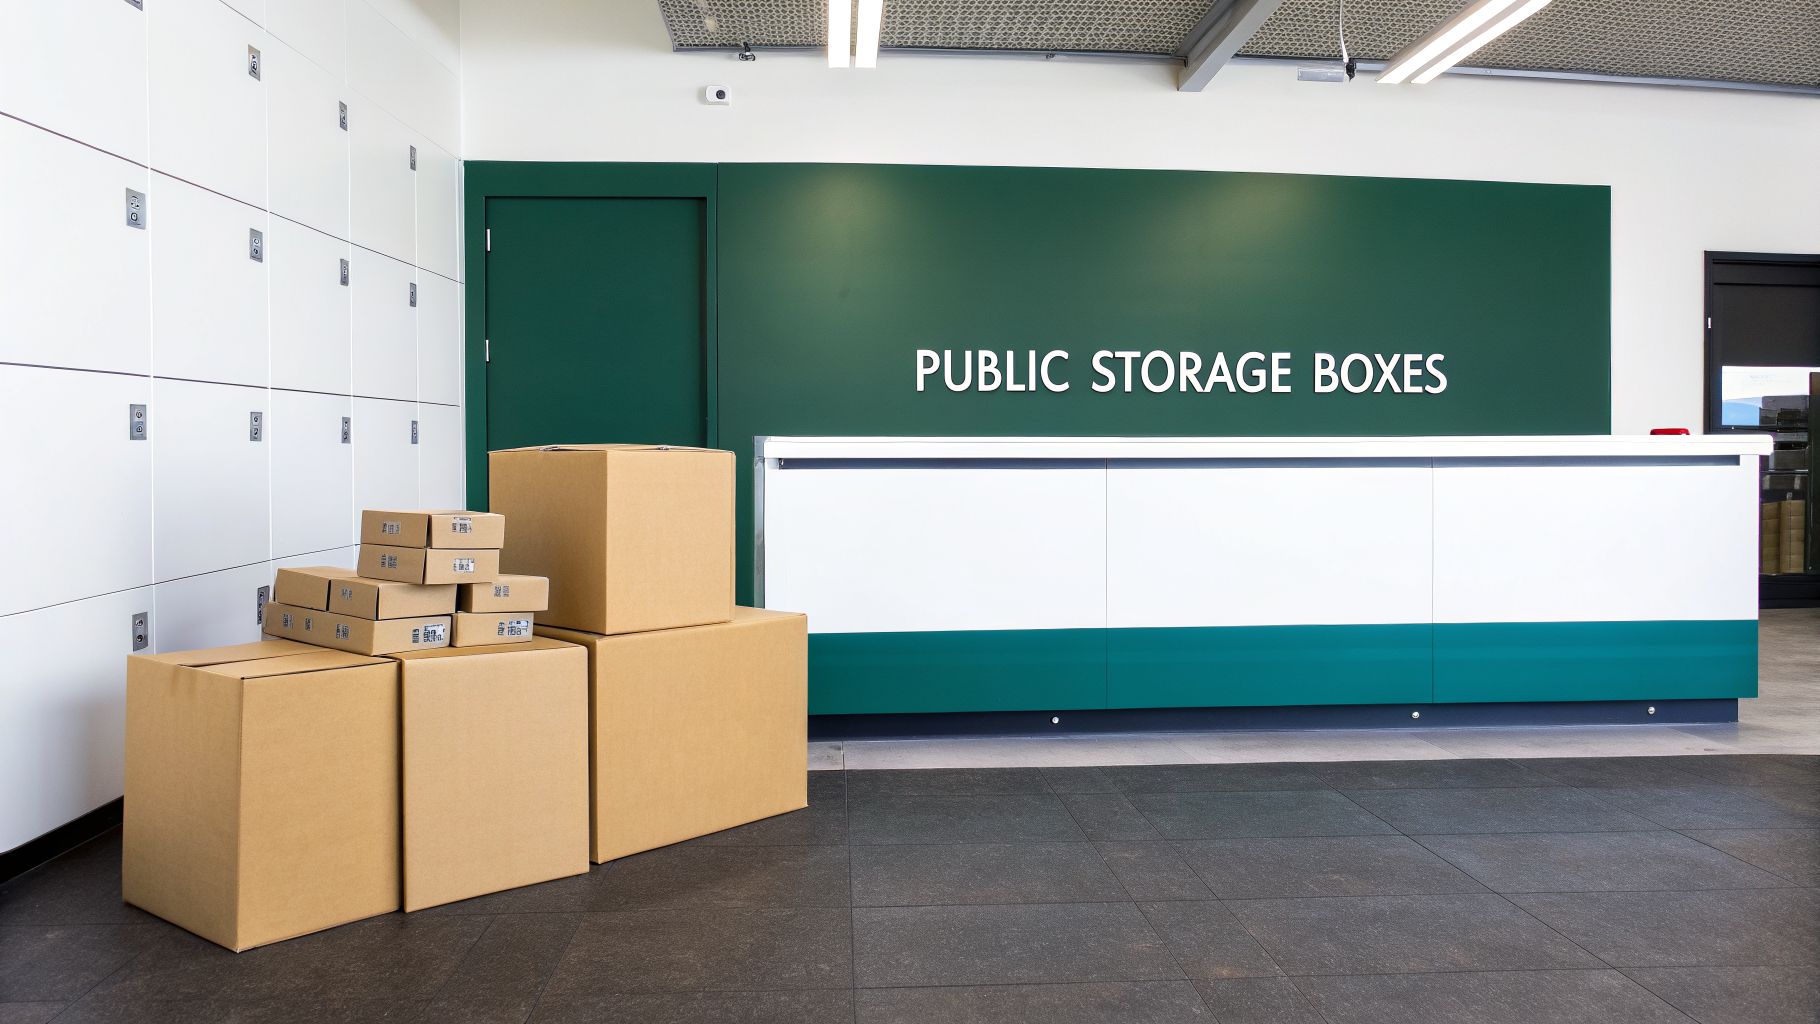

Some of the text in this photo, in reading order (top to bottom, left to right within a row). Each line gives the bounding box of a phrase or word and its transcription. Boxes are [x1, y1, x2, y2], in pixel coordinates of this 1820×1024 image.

[916, 349, 1448, 394] PUBLIC STORAGE BOXES
